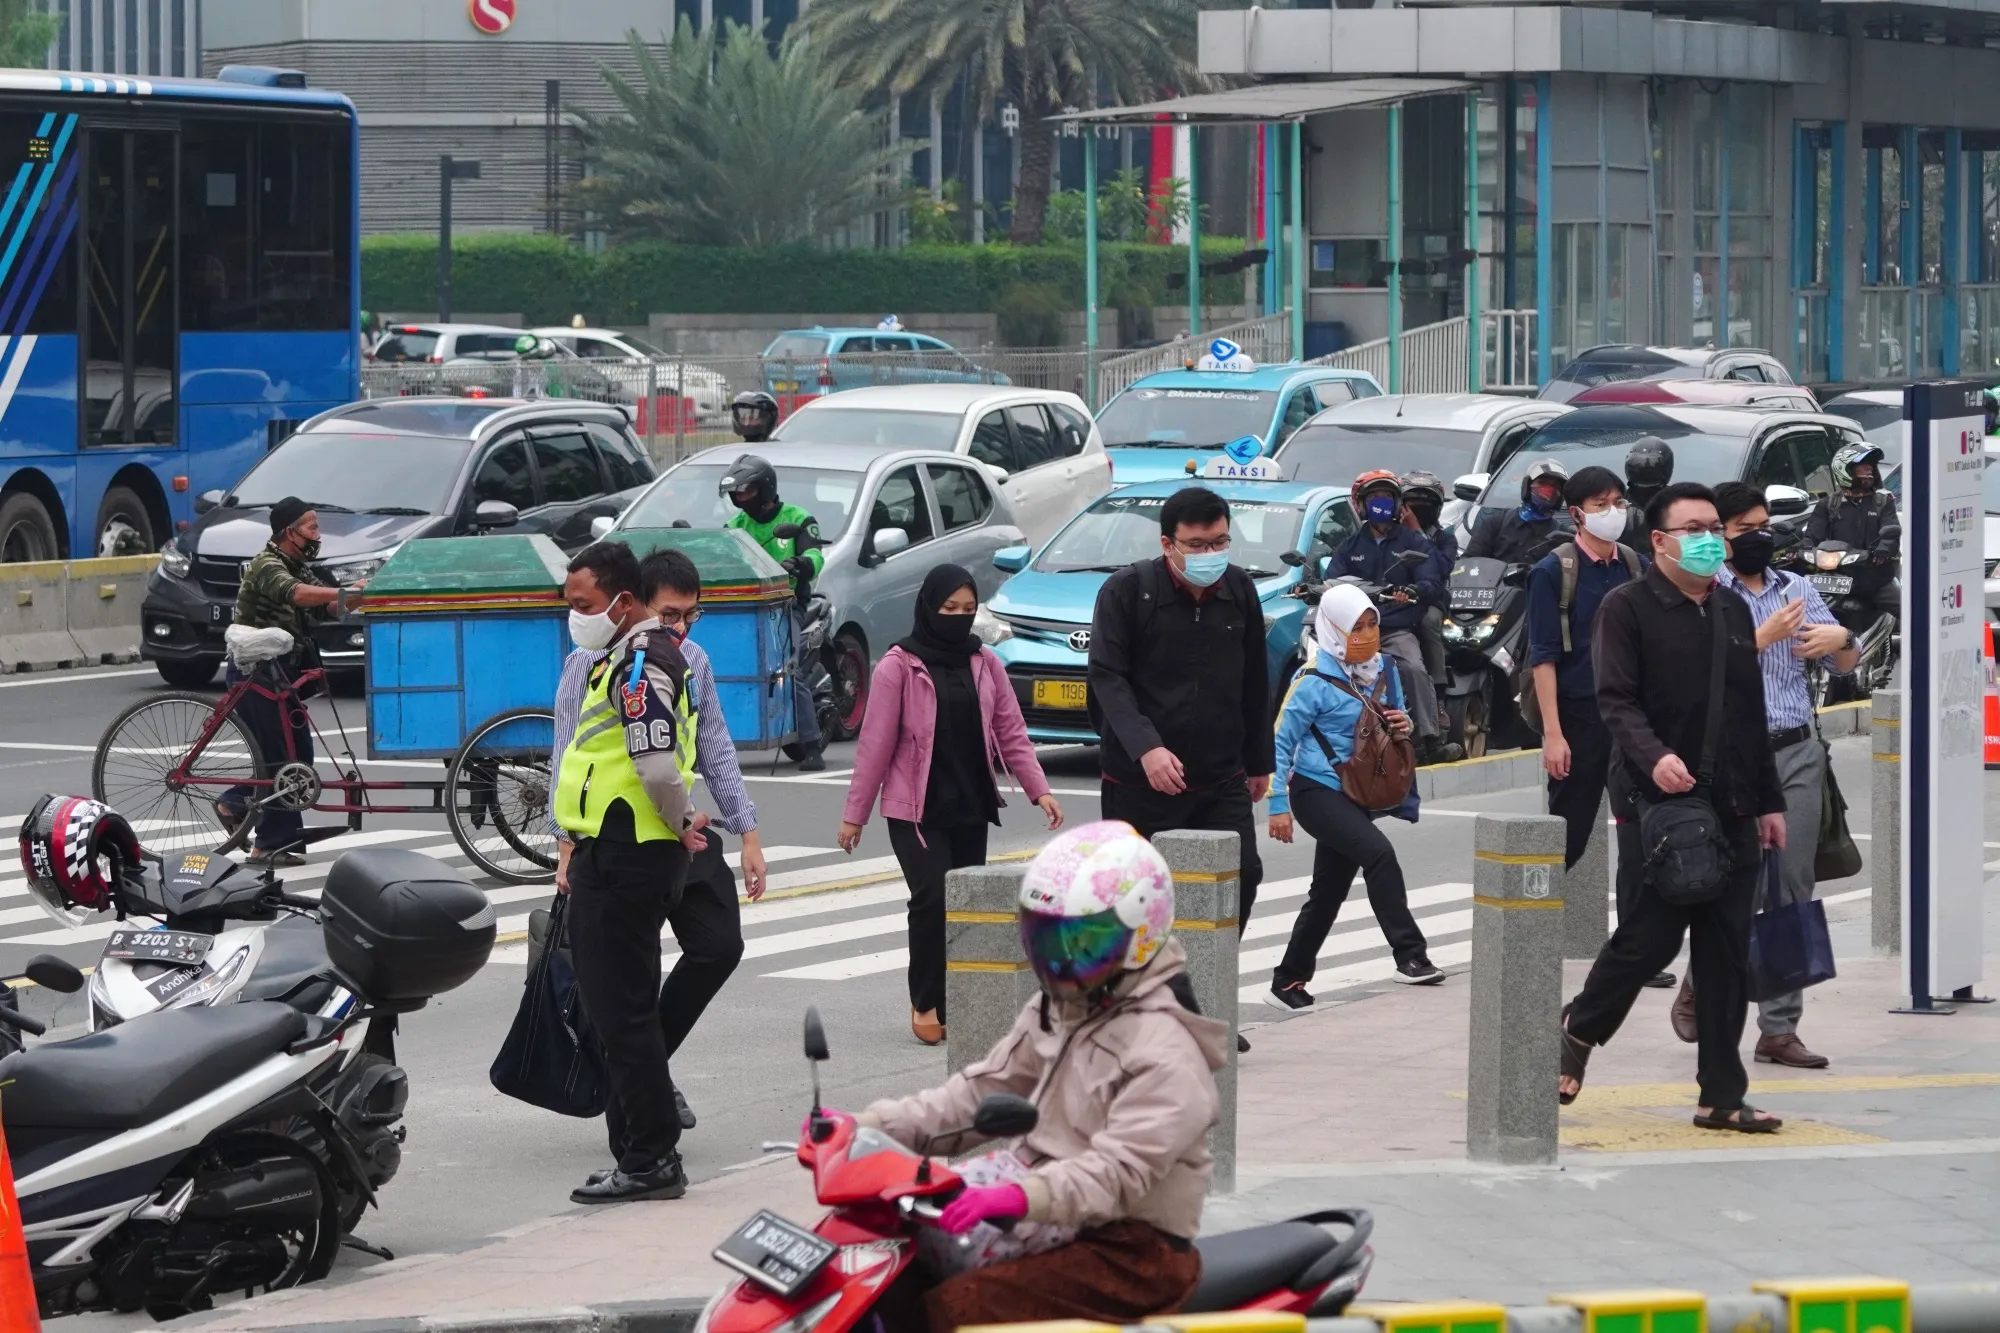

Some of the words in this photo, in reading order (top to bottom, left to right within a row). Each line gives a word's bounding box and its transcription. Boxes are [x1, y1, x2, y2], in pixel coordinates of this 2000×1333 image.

[1208, 361, 1242, 369] TAKSI
[1167, 390, 1225, 399] Bluebird
[1225, 392, 1259, 402] Group
[1217, 466, 1267, 477] TAKSI
[1231, 503, 1290, 513] GROUP
[1478, 590, 1493, 598] FES
[213, 605, 220, 620] B
[1037, 682, 1045, 698] B
[1061, 683, 1086, 700] 1196
[184, 855, 210, 863] TURN
[179, 867, 206, 876] CRIME
[173, 878, 202, 886] HONDA
[1030, 890, 1055, 904] GM
[111, 933, 124, 946] B
[131, 933, 171, 946] 3203
[158, 964, 203, 995] Andhika
